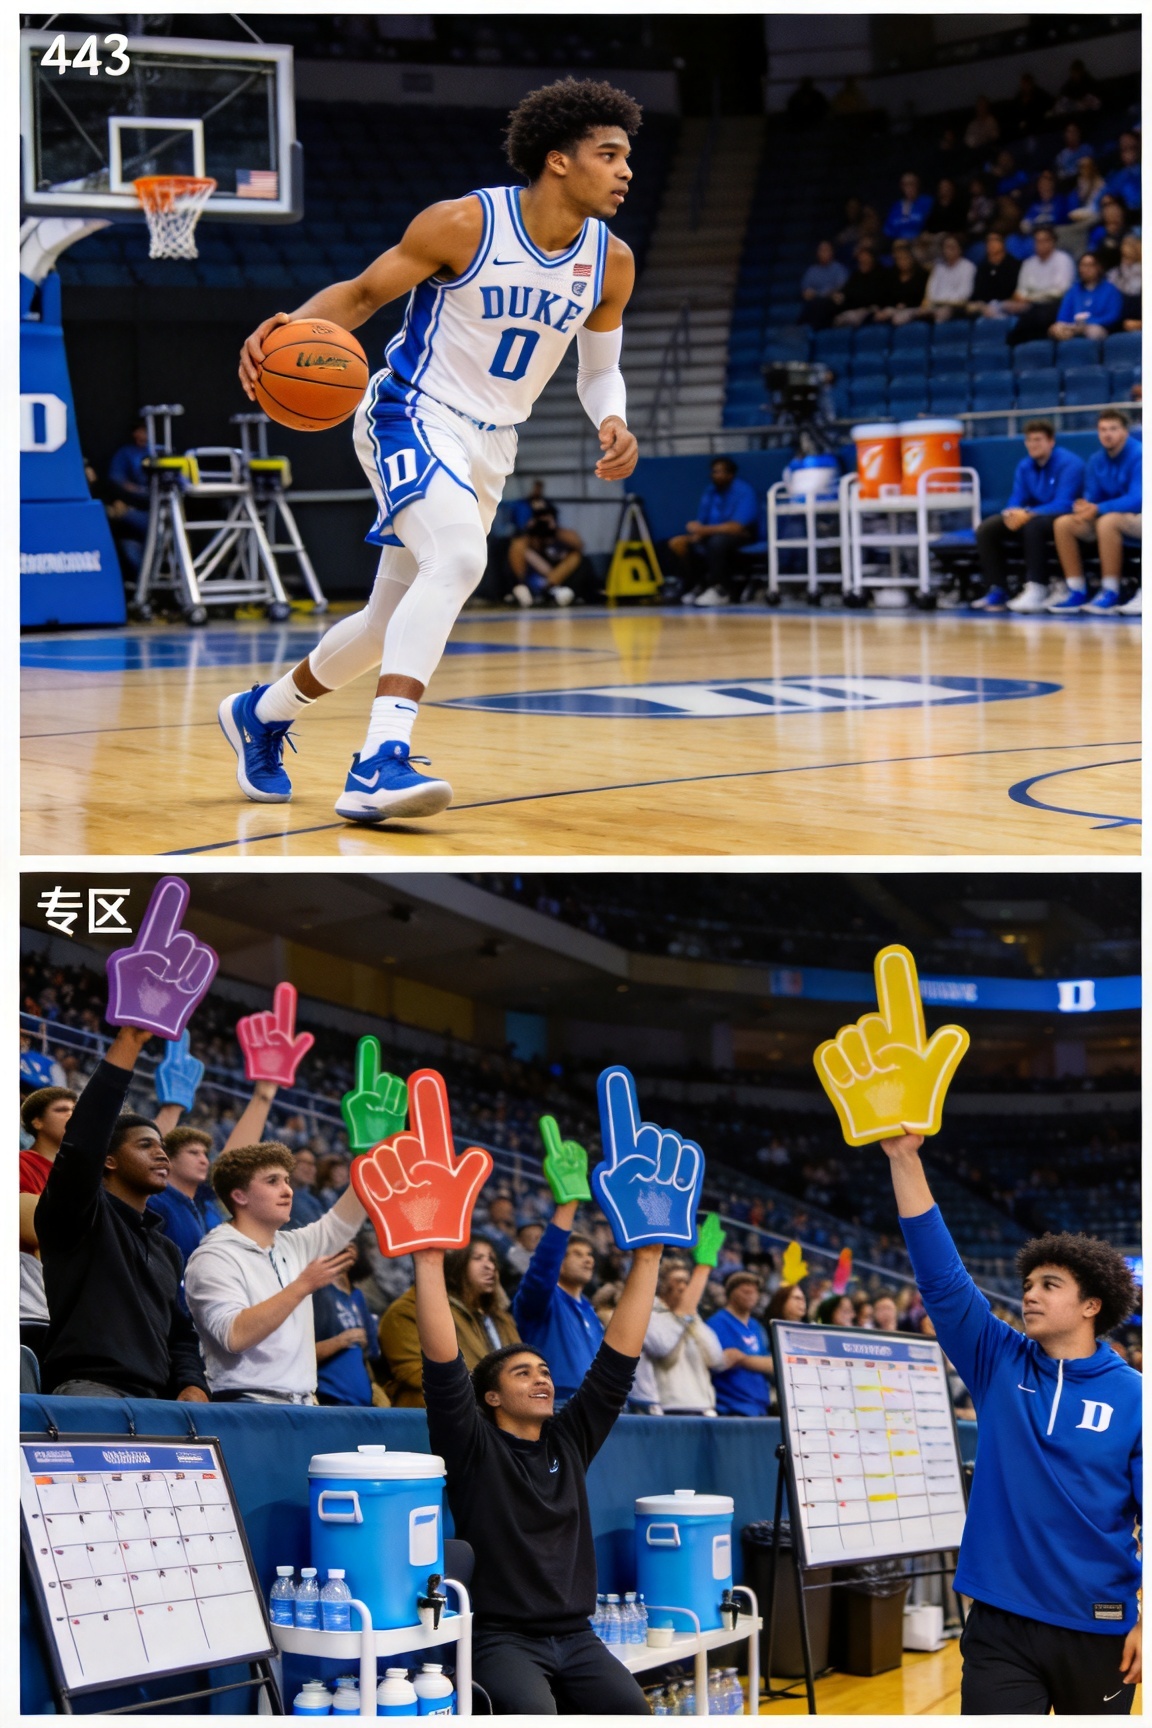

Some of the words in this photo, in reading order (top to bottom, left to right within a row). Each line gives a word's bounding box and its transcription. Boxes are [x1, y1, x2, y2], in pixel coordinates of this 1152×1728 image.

[479, 285, 584, 334] DUKE
[488, 327, 541, 382] 0
[383, 448, 418, 492] D
[1075, 1399, 1115, 1433] D
